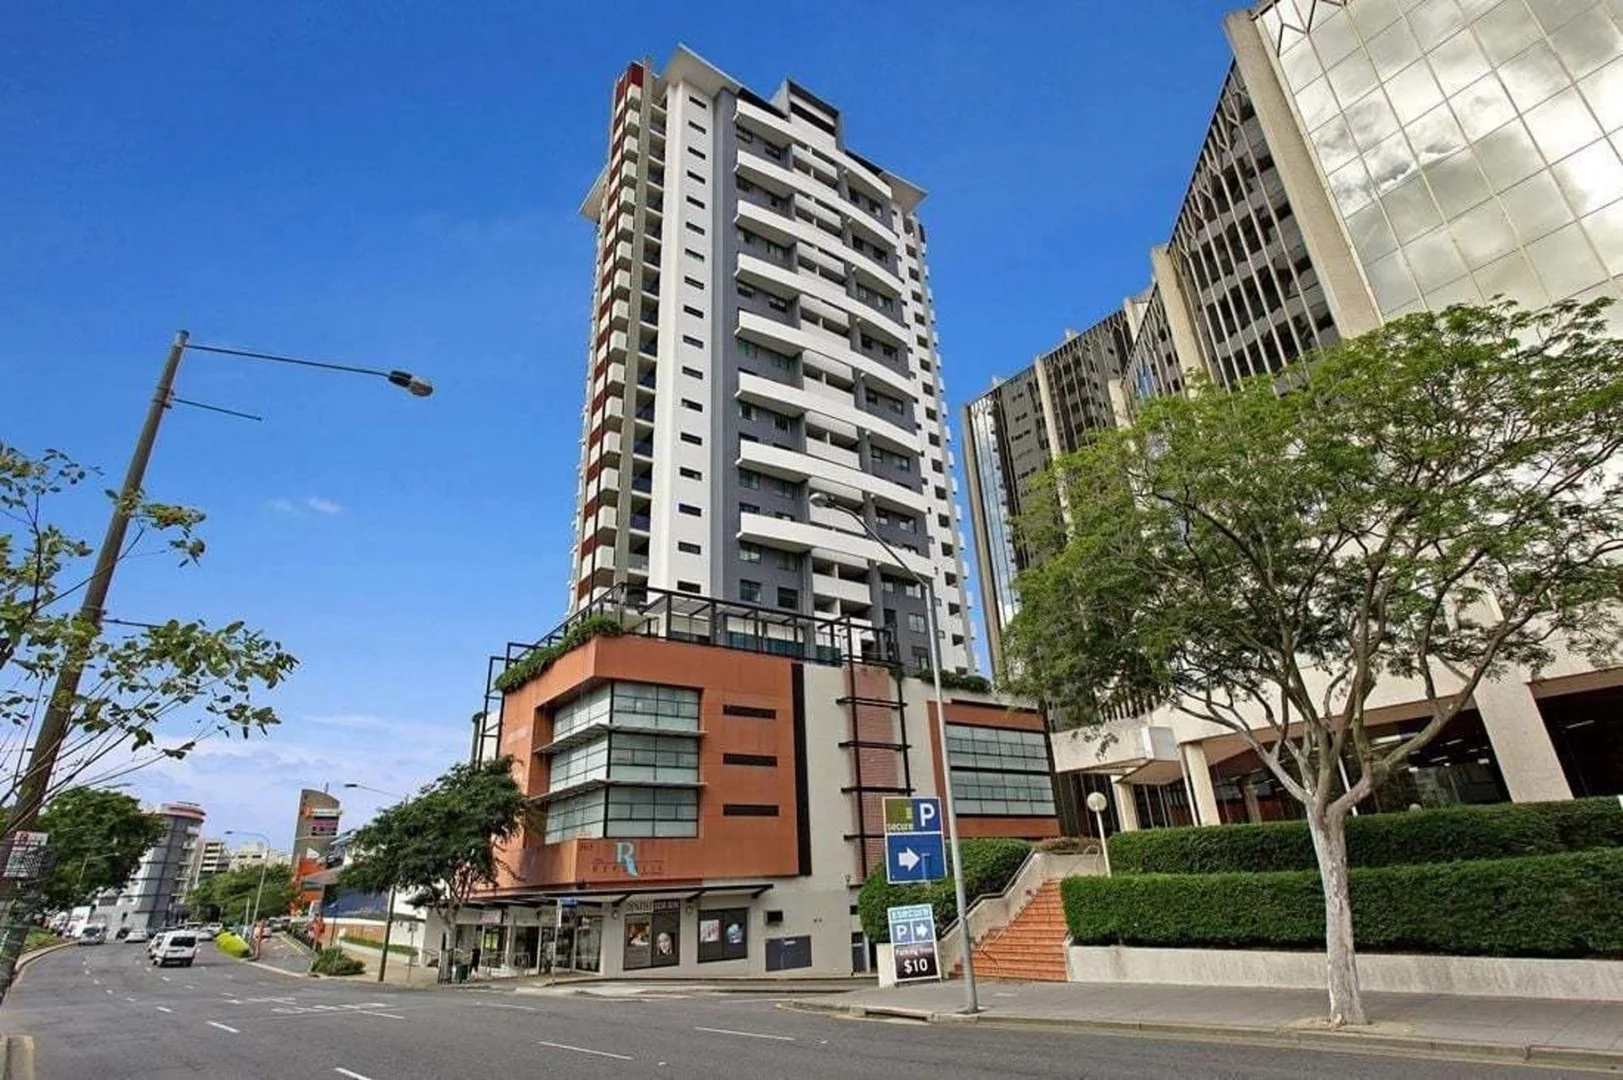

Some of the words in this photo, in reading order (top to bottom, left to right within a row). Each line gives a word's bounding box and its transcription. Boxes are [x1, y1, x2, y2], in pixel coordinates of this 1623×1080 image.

[919, 803, 935, 827] P
[614, 841, 639, 877] R
[896, 924, 908, 941] P
[904, 958, 928, 974] $10
